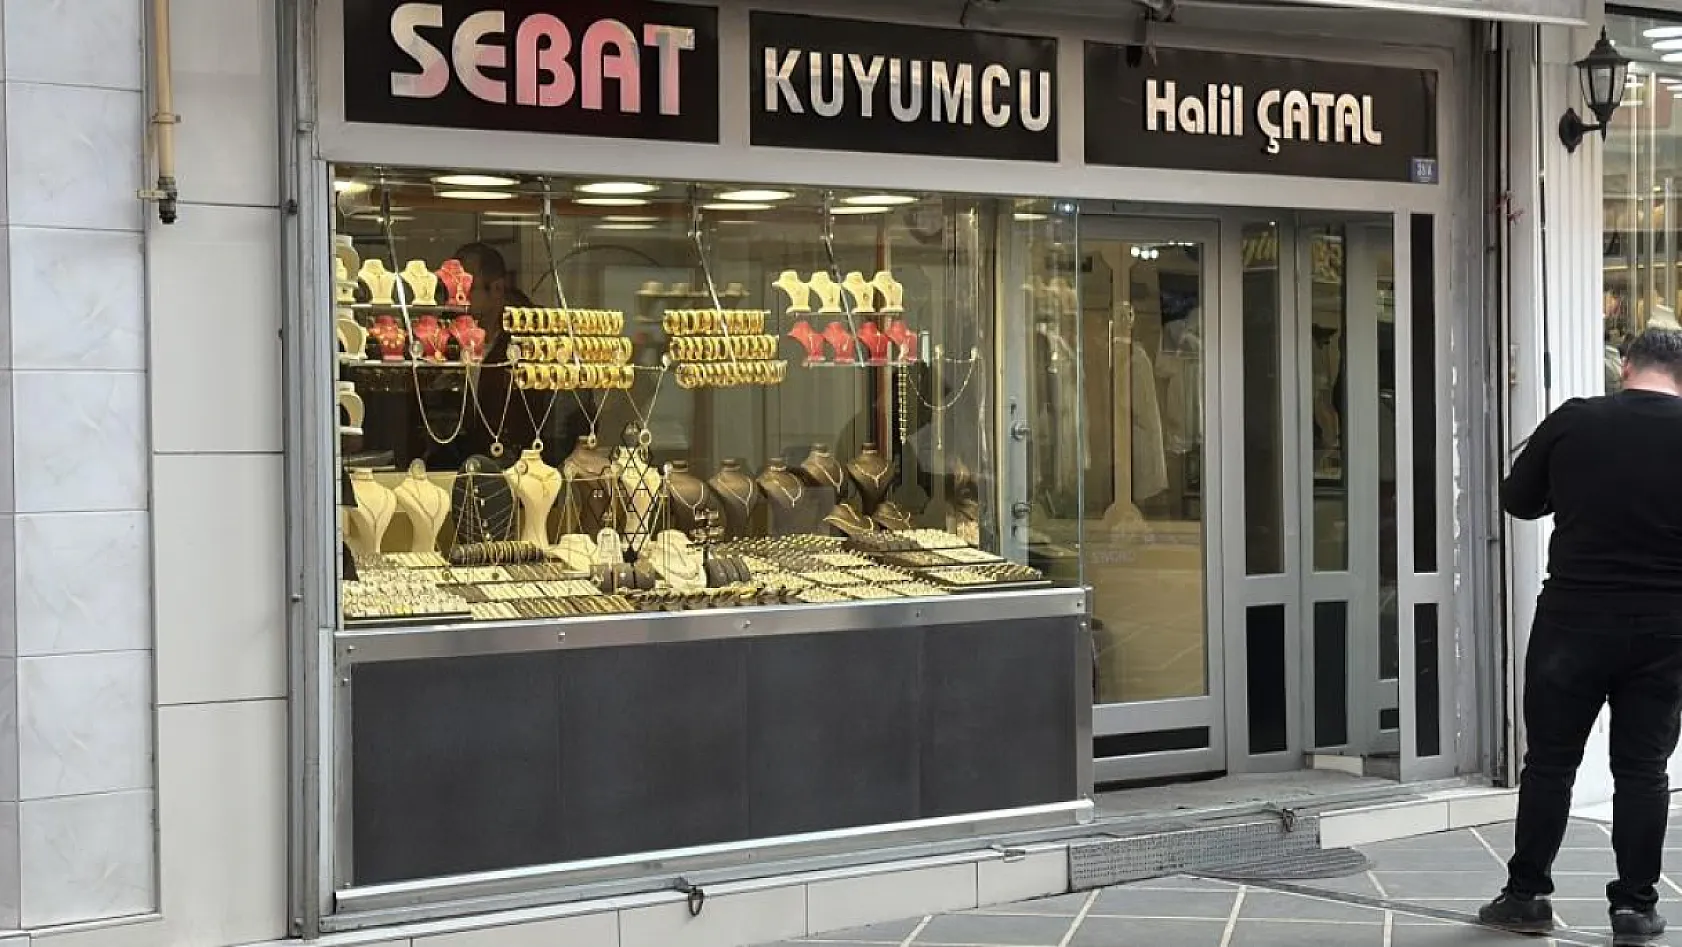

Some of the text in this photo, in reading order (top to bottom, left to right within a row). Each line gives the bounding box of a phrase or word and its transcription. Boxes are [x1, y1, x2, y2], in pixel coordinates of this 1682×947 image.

[390, 2, 696, 116] SEBAT
[763, 46, 1052, 132] KUYUMCU
[1146, 78, 1383, 155] Halil ÇATAL
